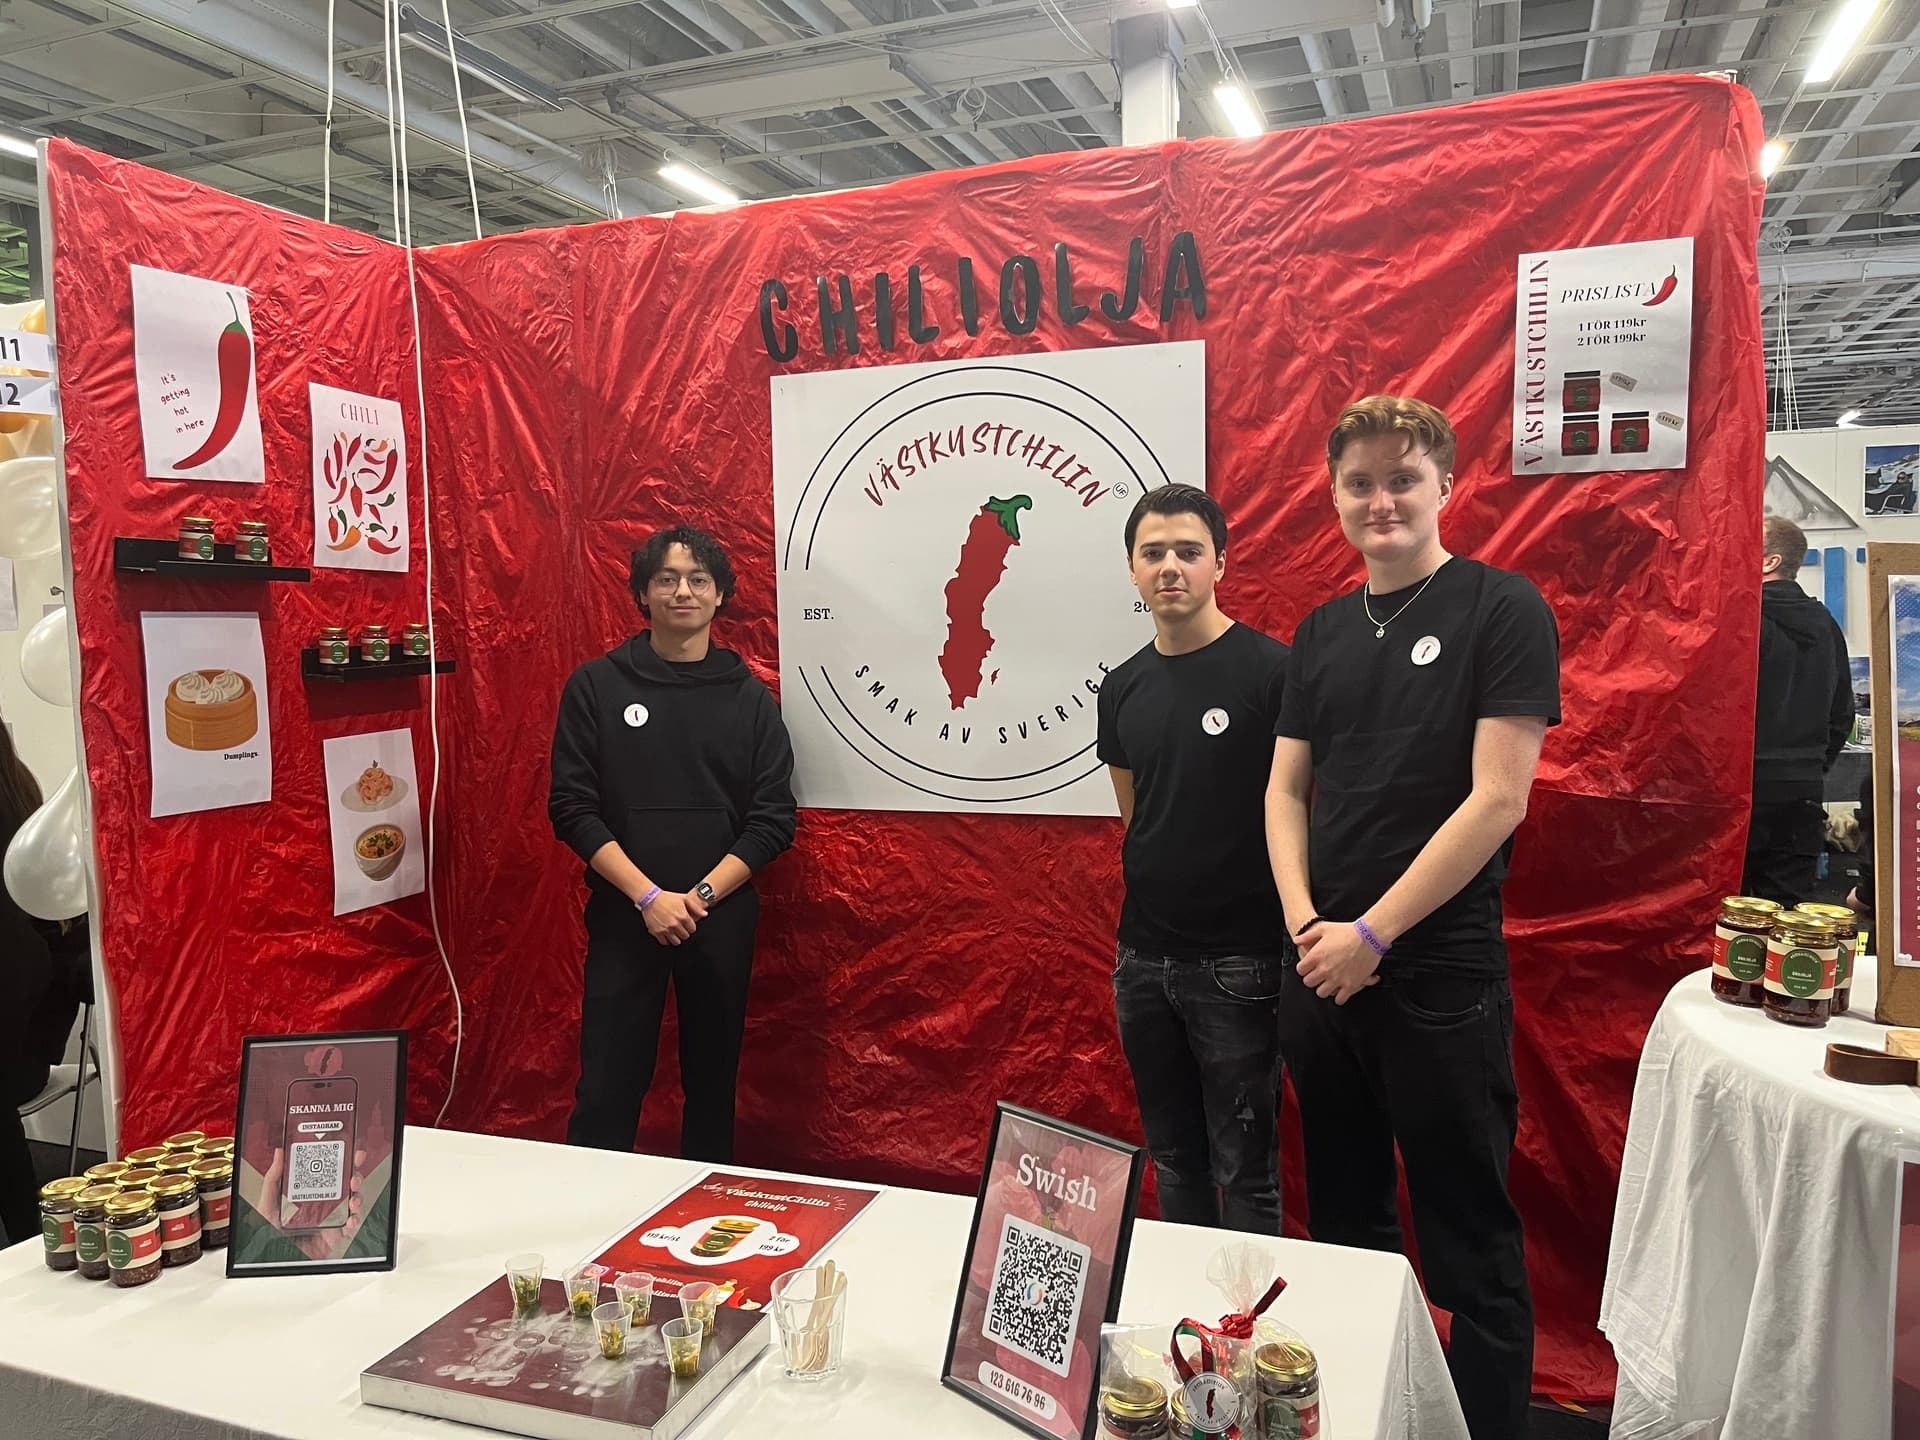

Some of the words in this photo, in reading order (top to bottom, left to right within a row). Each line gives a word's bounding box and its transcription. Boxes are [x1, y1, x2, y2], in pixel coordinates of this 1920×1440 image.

[759, 231, 1206, 363] CHILIOLJA
[1561, 282, 1656, 303] PRISLISTA
[1579, 323, 1583, 332] 1
[1615, 318, 1647, 329] 119kr
[1577, 337, 1584, 346] 2
[1614, 333, 1646, 344] 199kr
[1518, 259, 1549, 466] VÄSTKUSTCHILIN
[161, 373, 176, 385] It's
[161, 388, 190, 405] getting
[174, 406, 189, 416] hot
[341, 403, 379, 425] CHILI
[184, 420, 204, 430] here
[864, 422, 1111, 508] VÄSTKUSTCHILIN
[1115, 485, 1127, 497] UF
[804, 608, 834, 620] EST.
[1134, 602, 1152, 612] 20
[855, 665, 918, 726] SMAK
[939, 723, 971, 744] AV
[998, 662, 1109, 744] SVERIGE
[289, 1104, 331, 1114] SKANNA
[333, 1103, 354, 1112] MIG
[1015, 1153, 1096, 1212] Swish
[990, 1370, 1004, 1388] 123
[1005, 1378, 1020, 1397] 616
[1021, 1386, 1033, 1404] 76
[1034, 1393, 1046, 1411] 96
